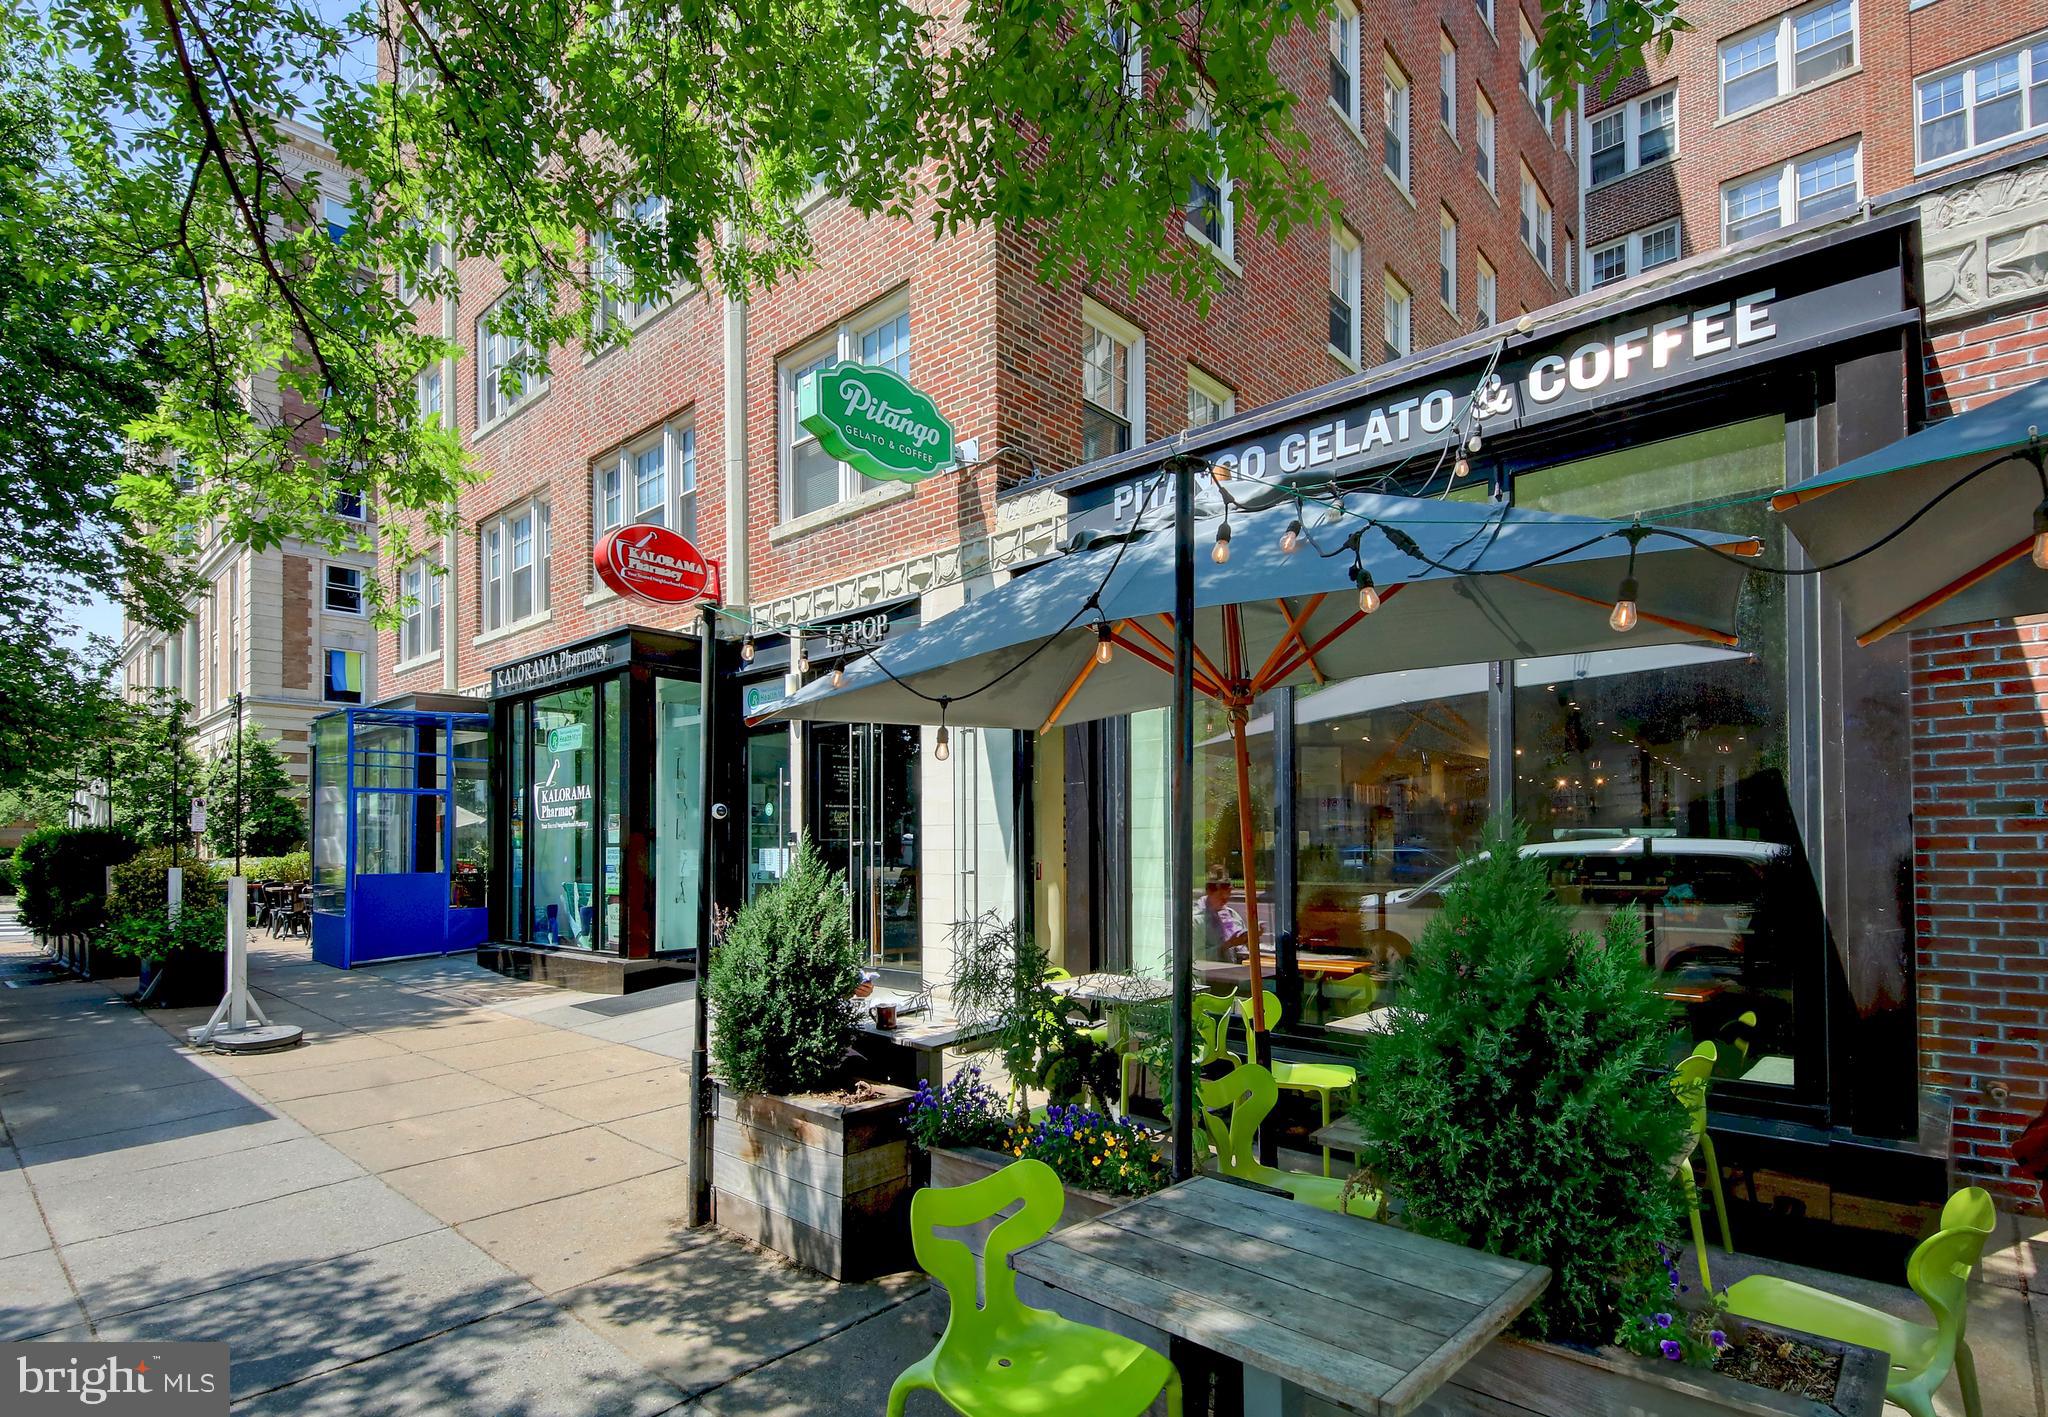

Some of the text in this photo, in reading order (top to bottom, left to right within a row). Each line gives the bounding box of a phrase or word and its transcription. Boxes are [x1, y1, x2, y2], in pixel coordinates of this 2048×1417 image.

[1279, 389, 1453, 474] GELATO
[1471, 373, 1512, 420] &
[1528, 287, 1776, 403] COFFEE
[839, 379, 940, 447] Pitango
[845, 425, 933, 464] GELATO & COFFEE
[628, 547, 705, 575] KALORAMA
[628, 558, 683, 582] Pharmacy
[496, 644, 611, 688] KALORAMA Pharmacy
[542, 785, 591, 803] KALORAMA
[541, 805, 576, 819] Pharmacy
